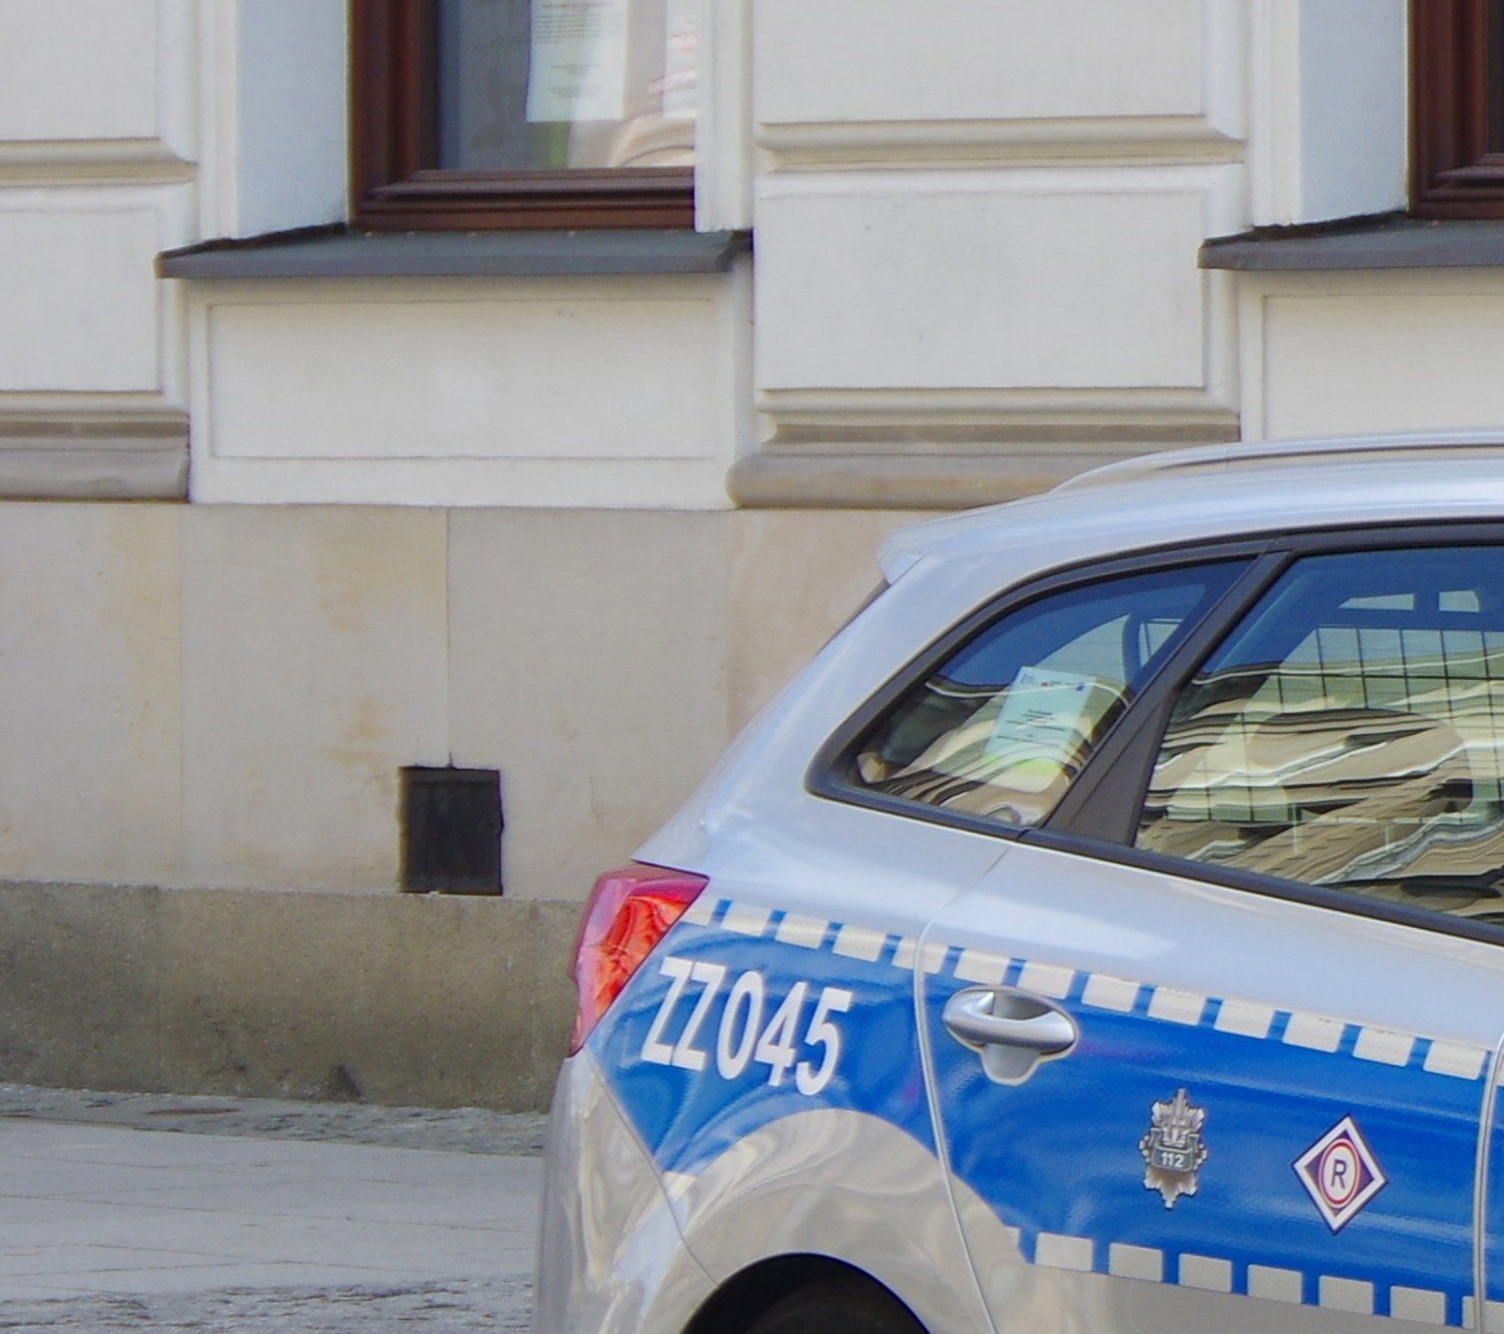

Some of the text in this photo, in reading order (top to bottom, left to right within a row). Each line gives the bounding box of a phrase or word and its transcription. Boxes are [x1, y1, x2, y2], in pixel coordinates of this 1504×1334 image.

[640, 956, 855, 1096] ZZ045
[1161, 1151, 1184, 1167] 112
[1331, 1158, 1346, 1189] R
